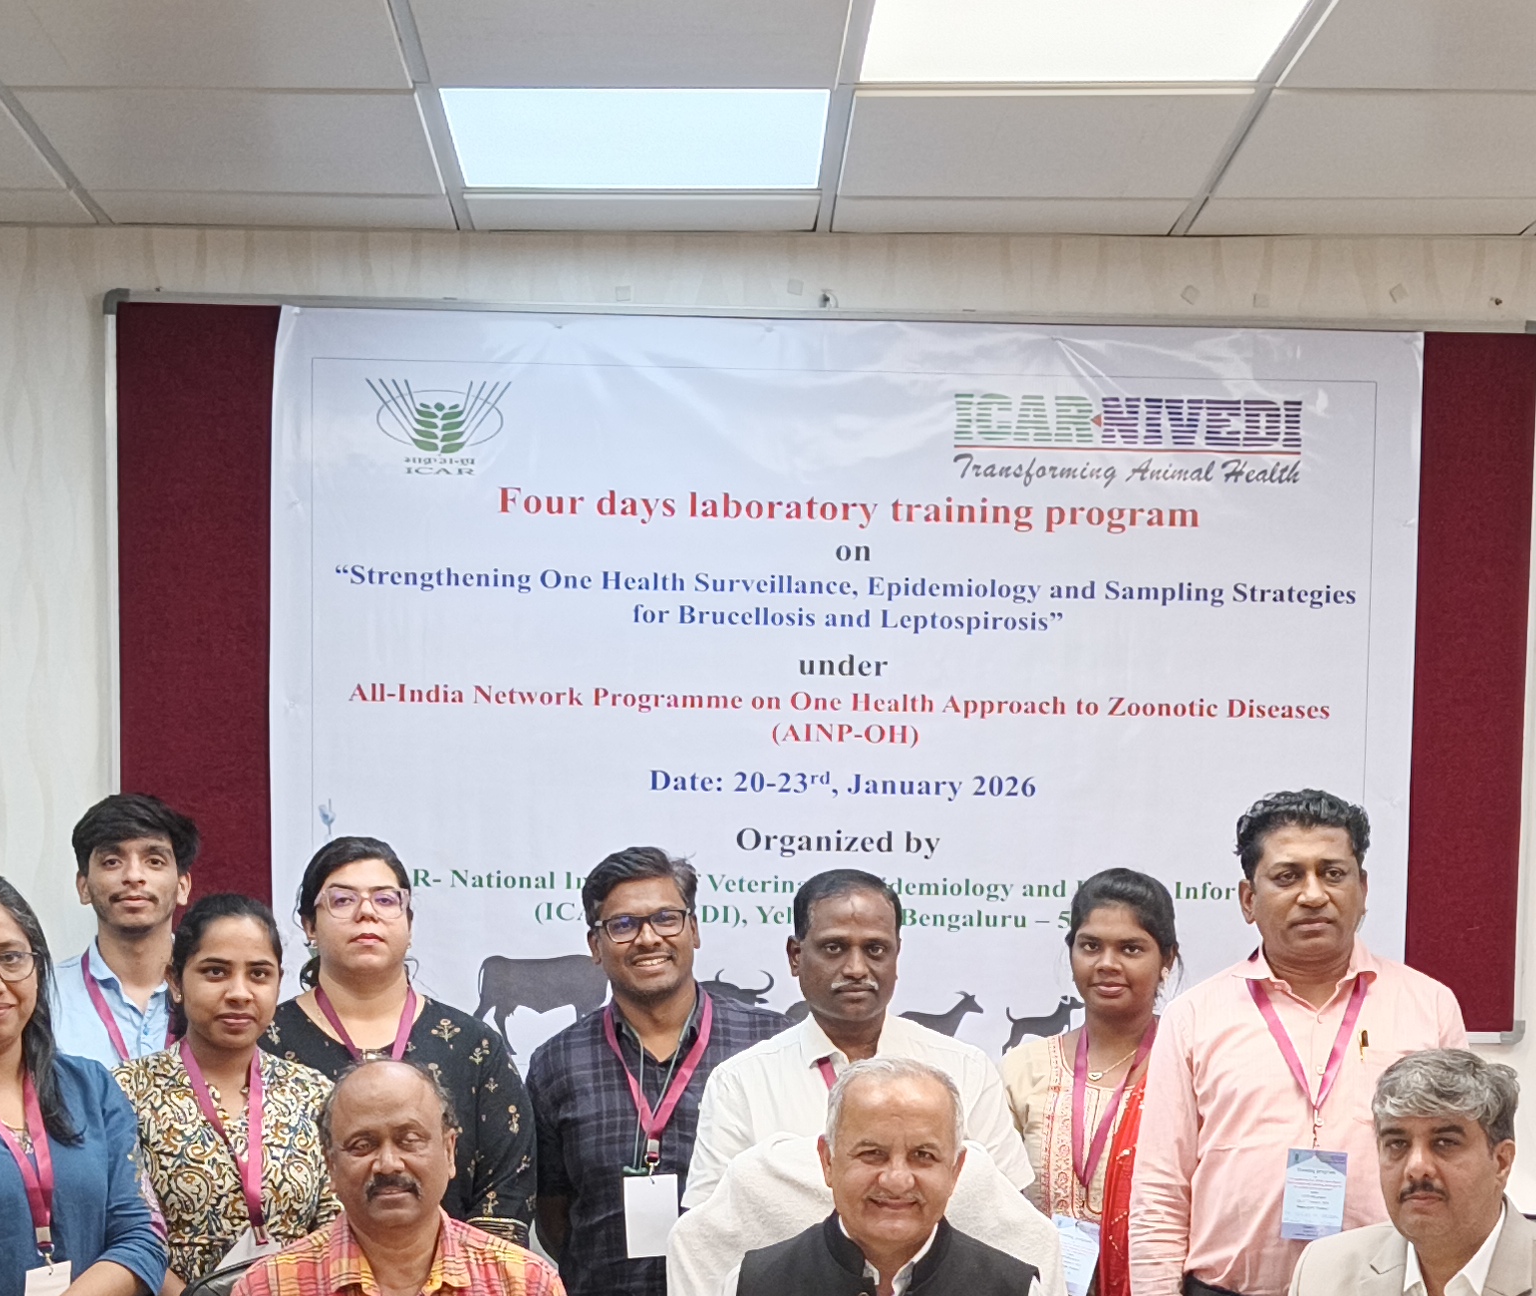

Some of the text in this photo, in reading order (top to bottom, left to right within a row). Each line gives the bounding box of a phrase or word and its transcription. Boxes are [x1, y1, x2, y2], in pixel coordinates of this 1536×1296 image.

[405, 466, 475, 476] ICAR
[952, 452, 1301, 489] Transforming Animal Health
[499, 486, 1199, 535] Four days laboratory training program
[835, 544, 871, 562] on
[334, 564, 1357, 610] “Strengthening One Health Surveillance, Epidemiology and Sampling Strategies
[633, 603, 1064, 636] for Brucellosis and Leptospirosis”
[799, 653, 889, 677] under
[348, 682, 1331, 720] All-India Network Programme on One Health Approach to Zoonotic Diseases
[771, 722, 919, 749] (AINP-OH)
[650, 769, 1036, 802] Date: 20-23rd, January 2026
[736, 827, 941, 860] Organized by
[449, 869, 555, 890] National
[1021, 879, 1066, 898] and
[902, 908, 1027, 933] Bengaluru
